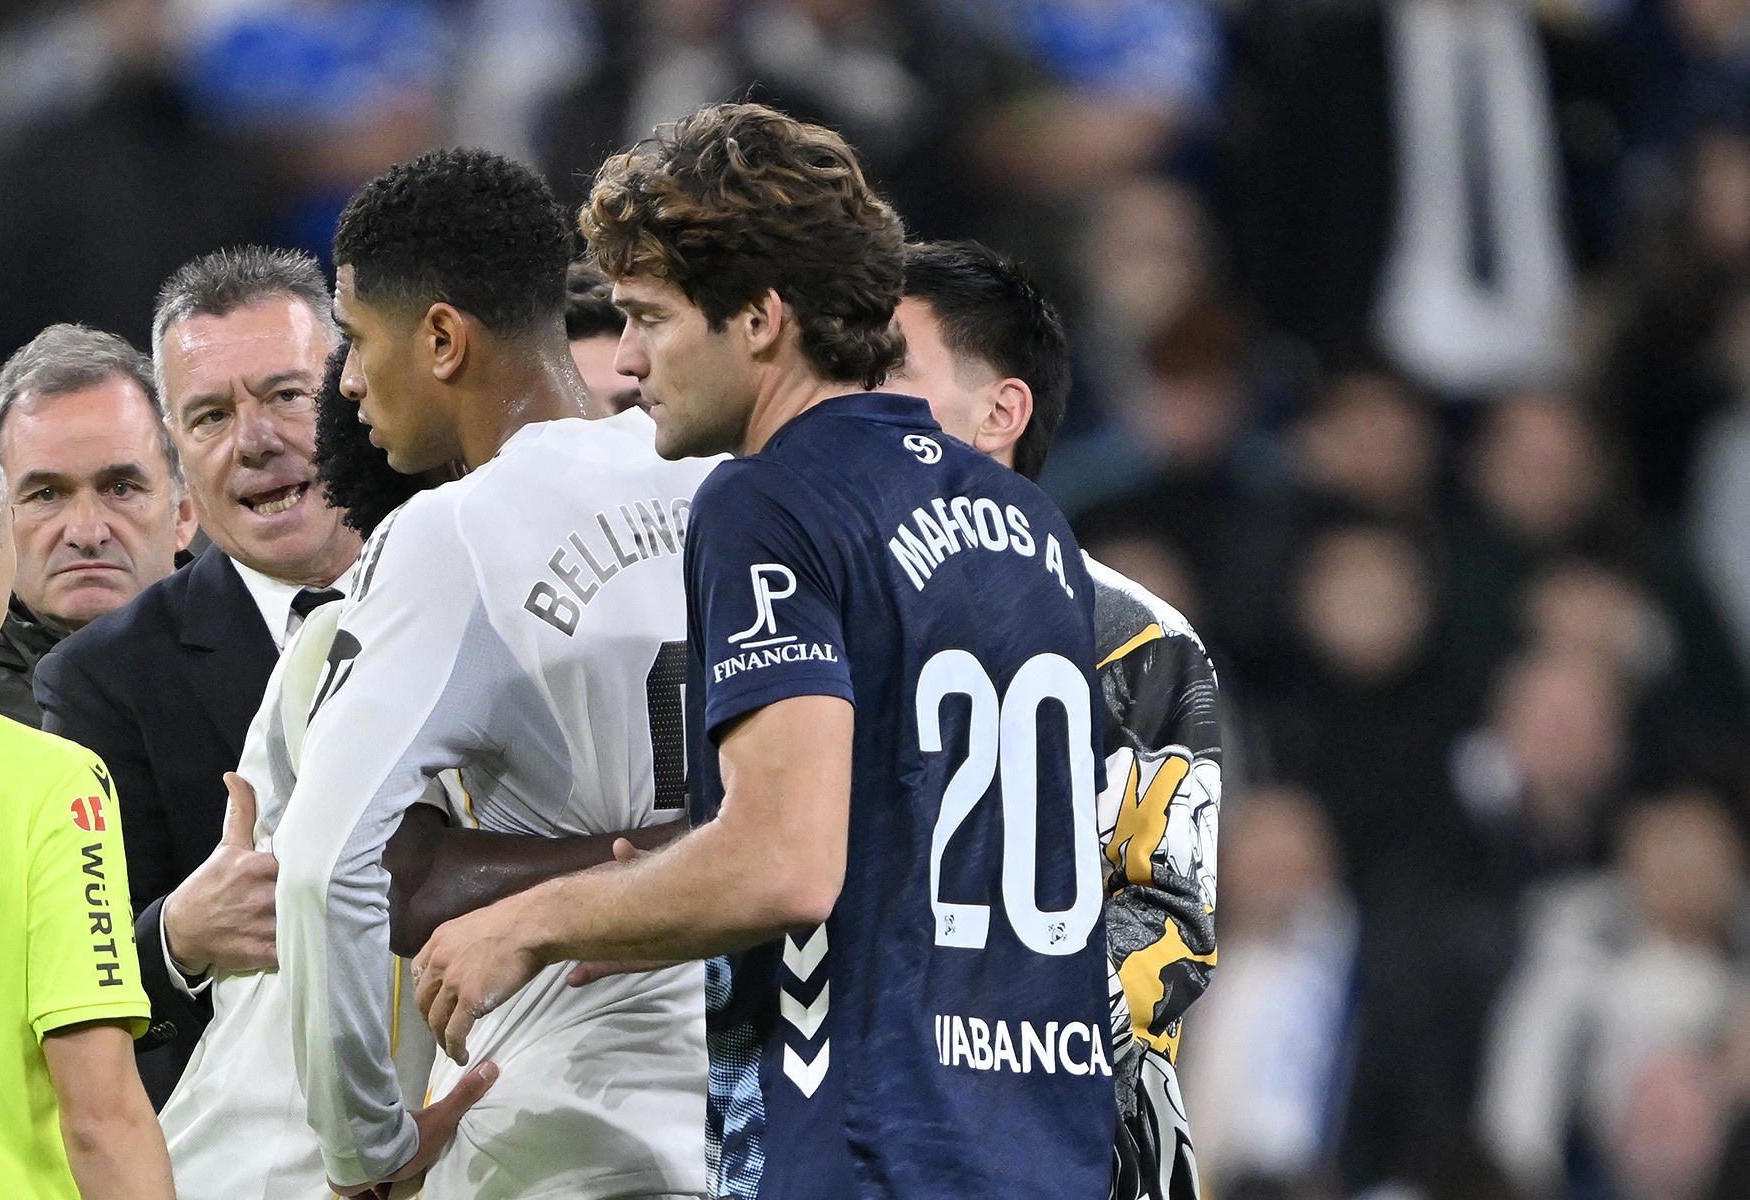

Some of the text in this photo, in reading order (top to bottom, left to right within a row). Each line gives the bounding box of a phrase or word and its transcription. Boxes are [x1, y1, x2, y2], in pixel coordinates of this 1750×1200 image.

[713, 643, 838, 683] FINANCIAL
[915, 649, 1105, 956] 20
[81, 843, 123, 987] WÜRTH
